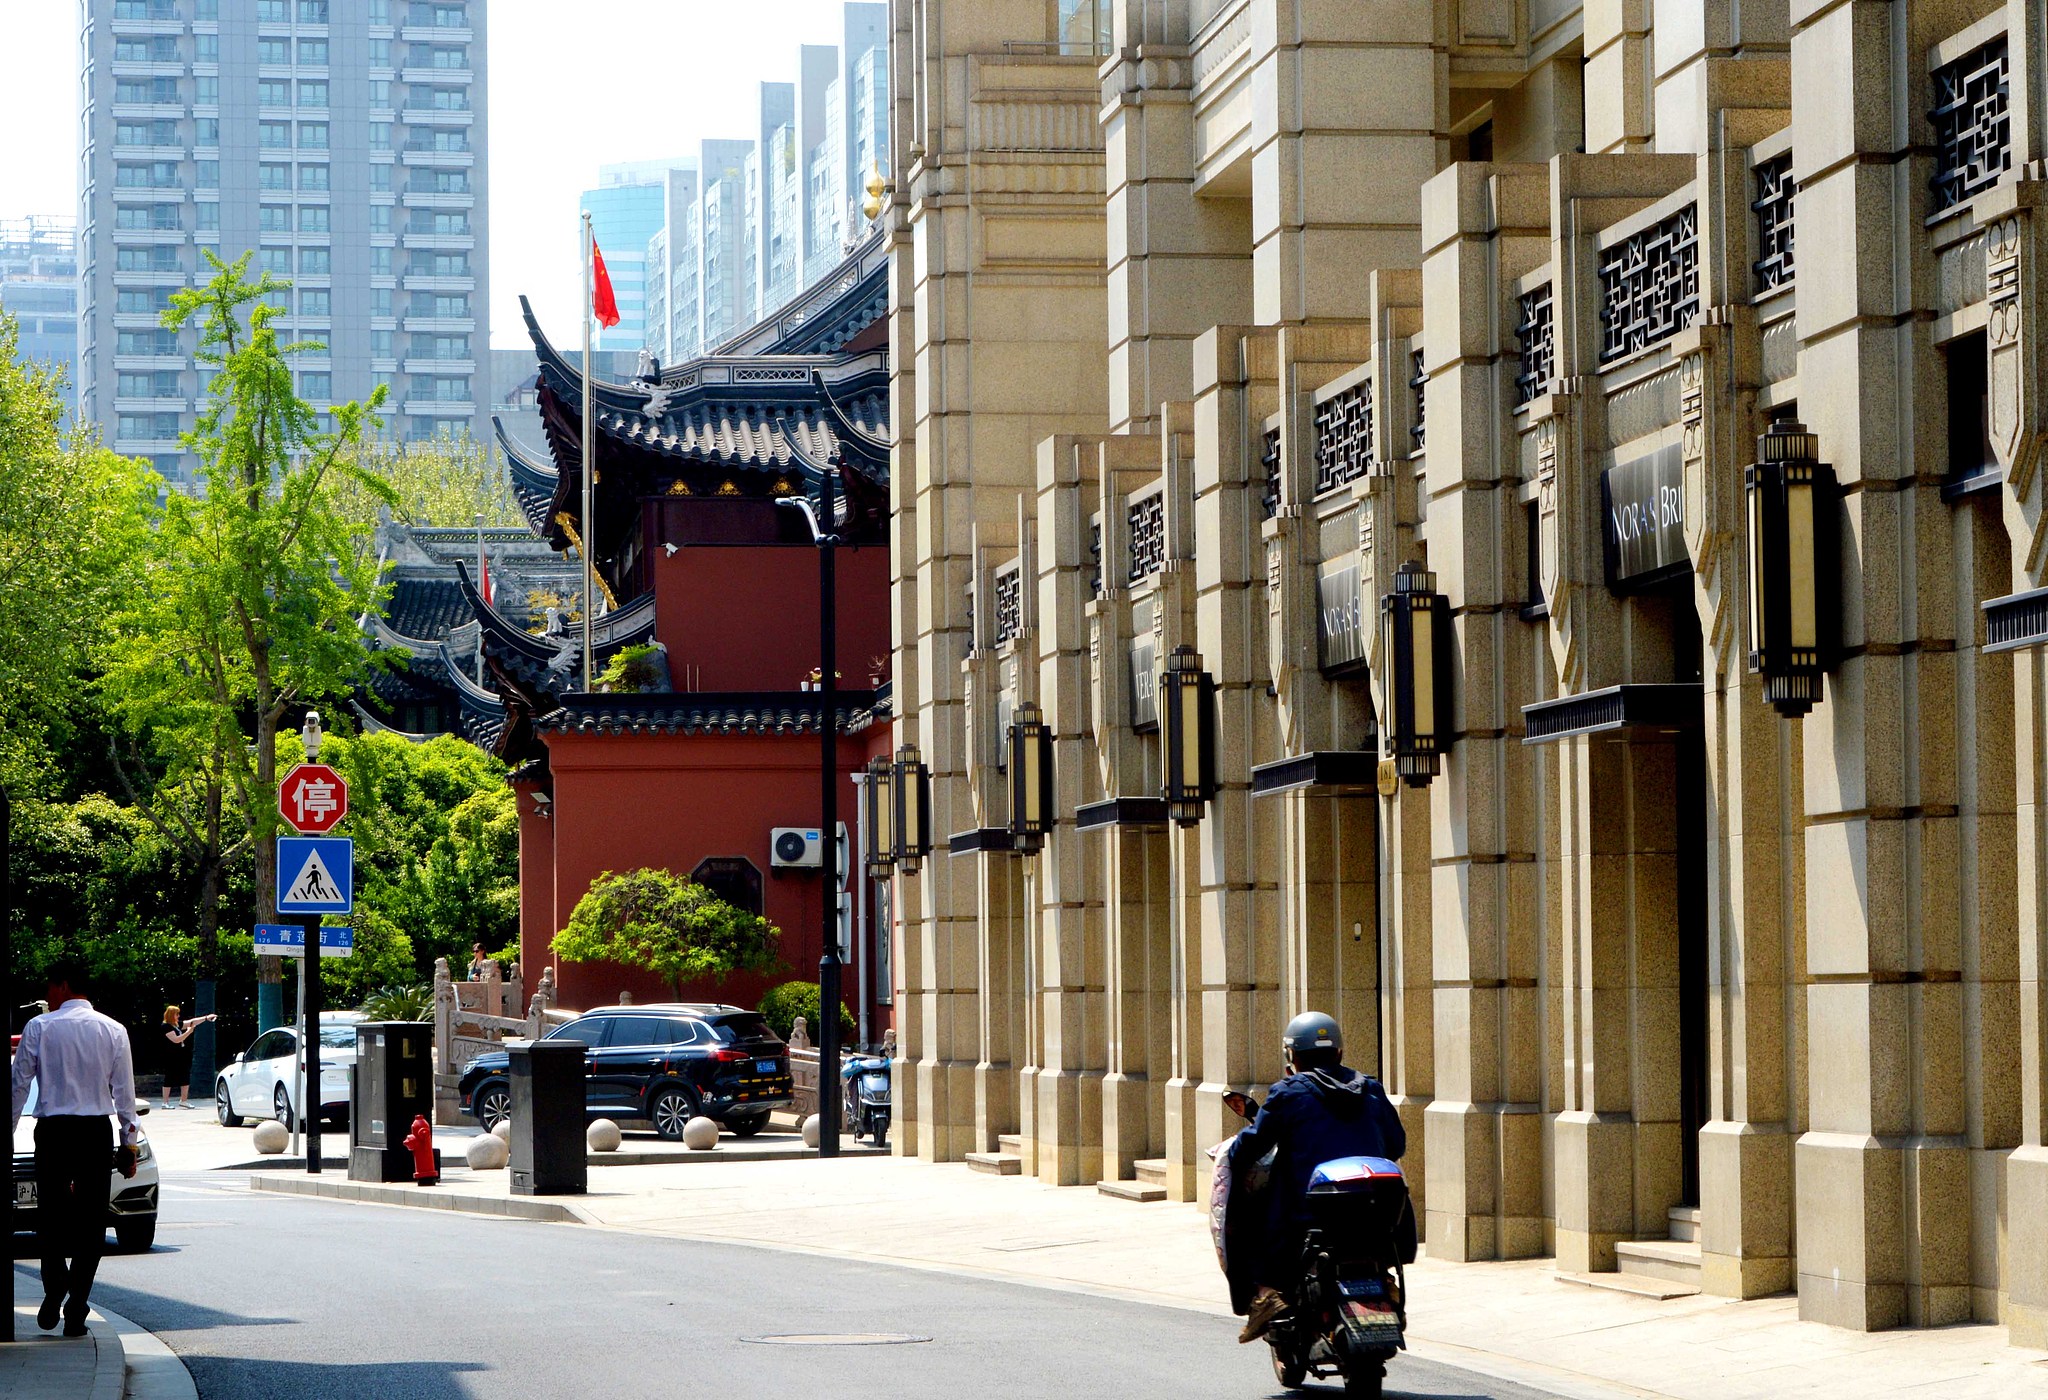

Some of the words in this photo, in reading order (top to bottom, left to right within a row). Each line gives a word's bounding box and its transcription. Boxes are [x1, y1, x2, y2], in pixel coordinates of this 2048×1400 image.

[1661, 485, 1684, 528] BRI
[291, 777, 337, 823] 停
[339, 931, 347, 939] 北
[260, 945, 266, 953] S
